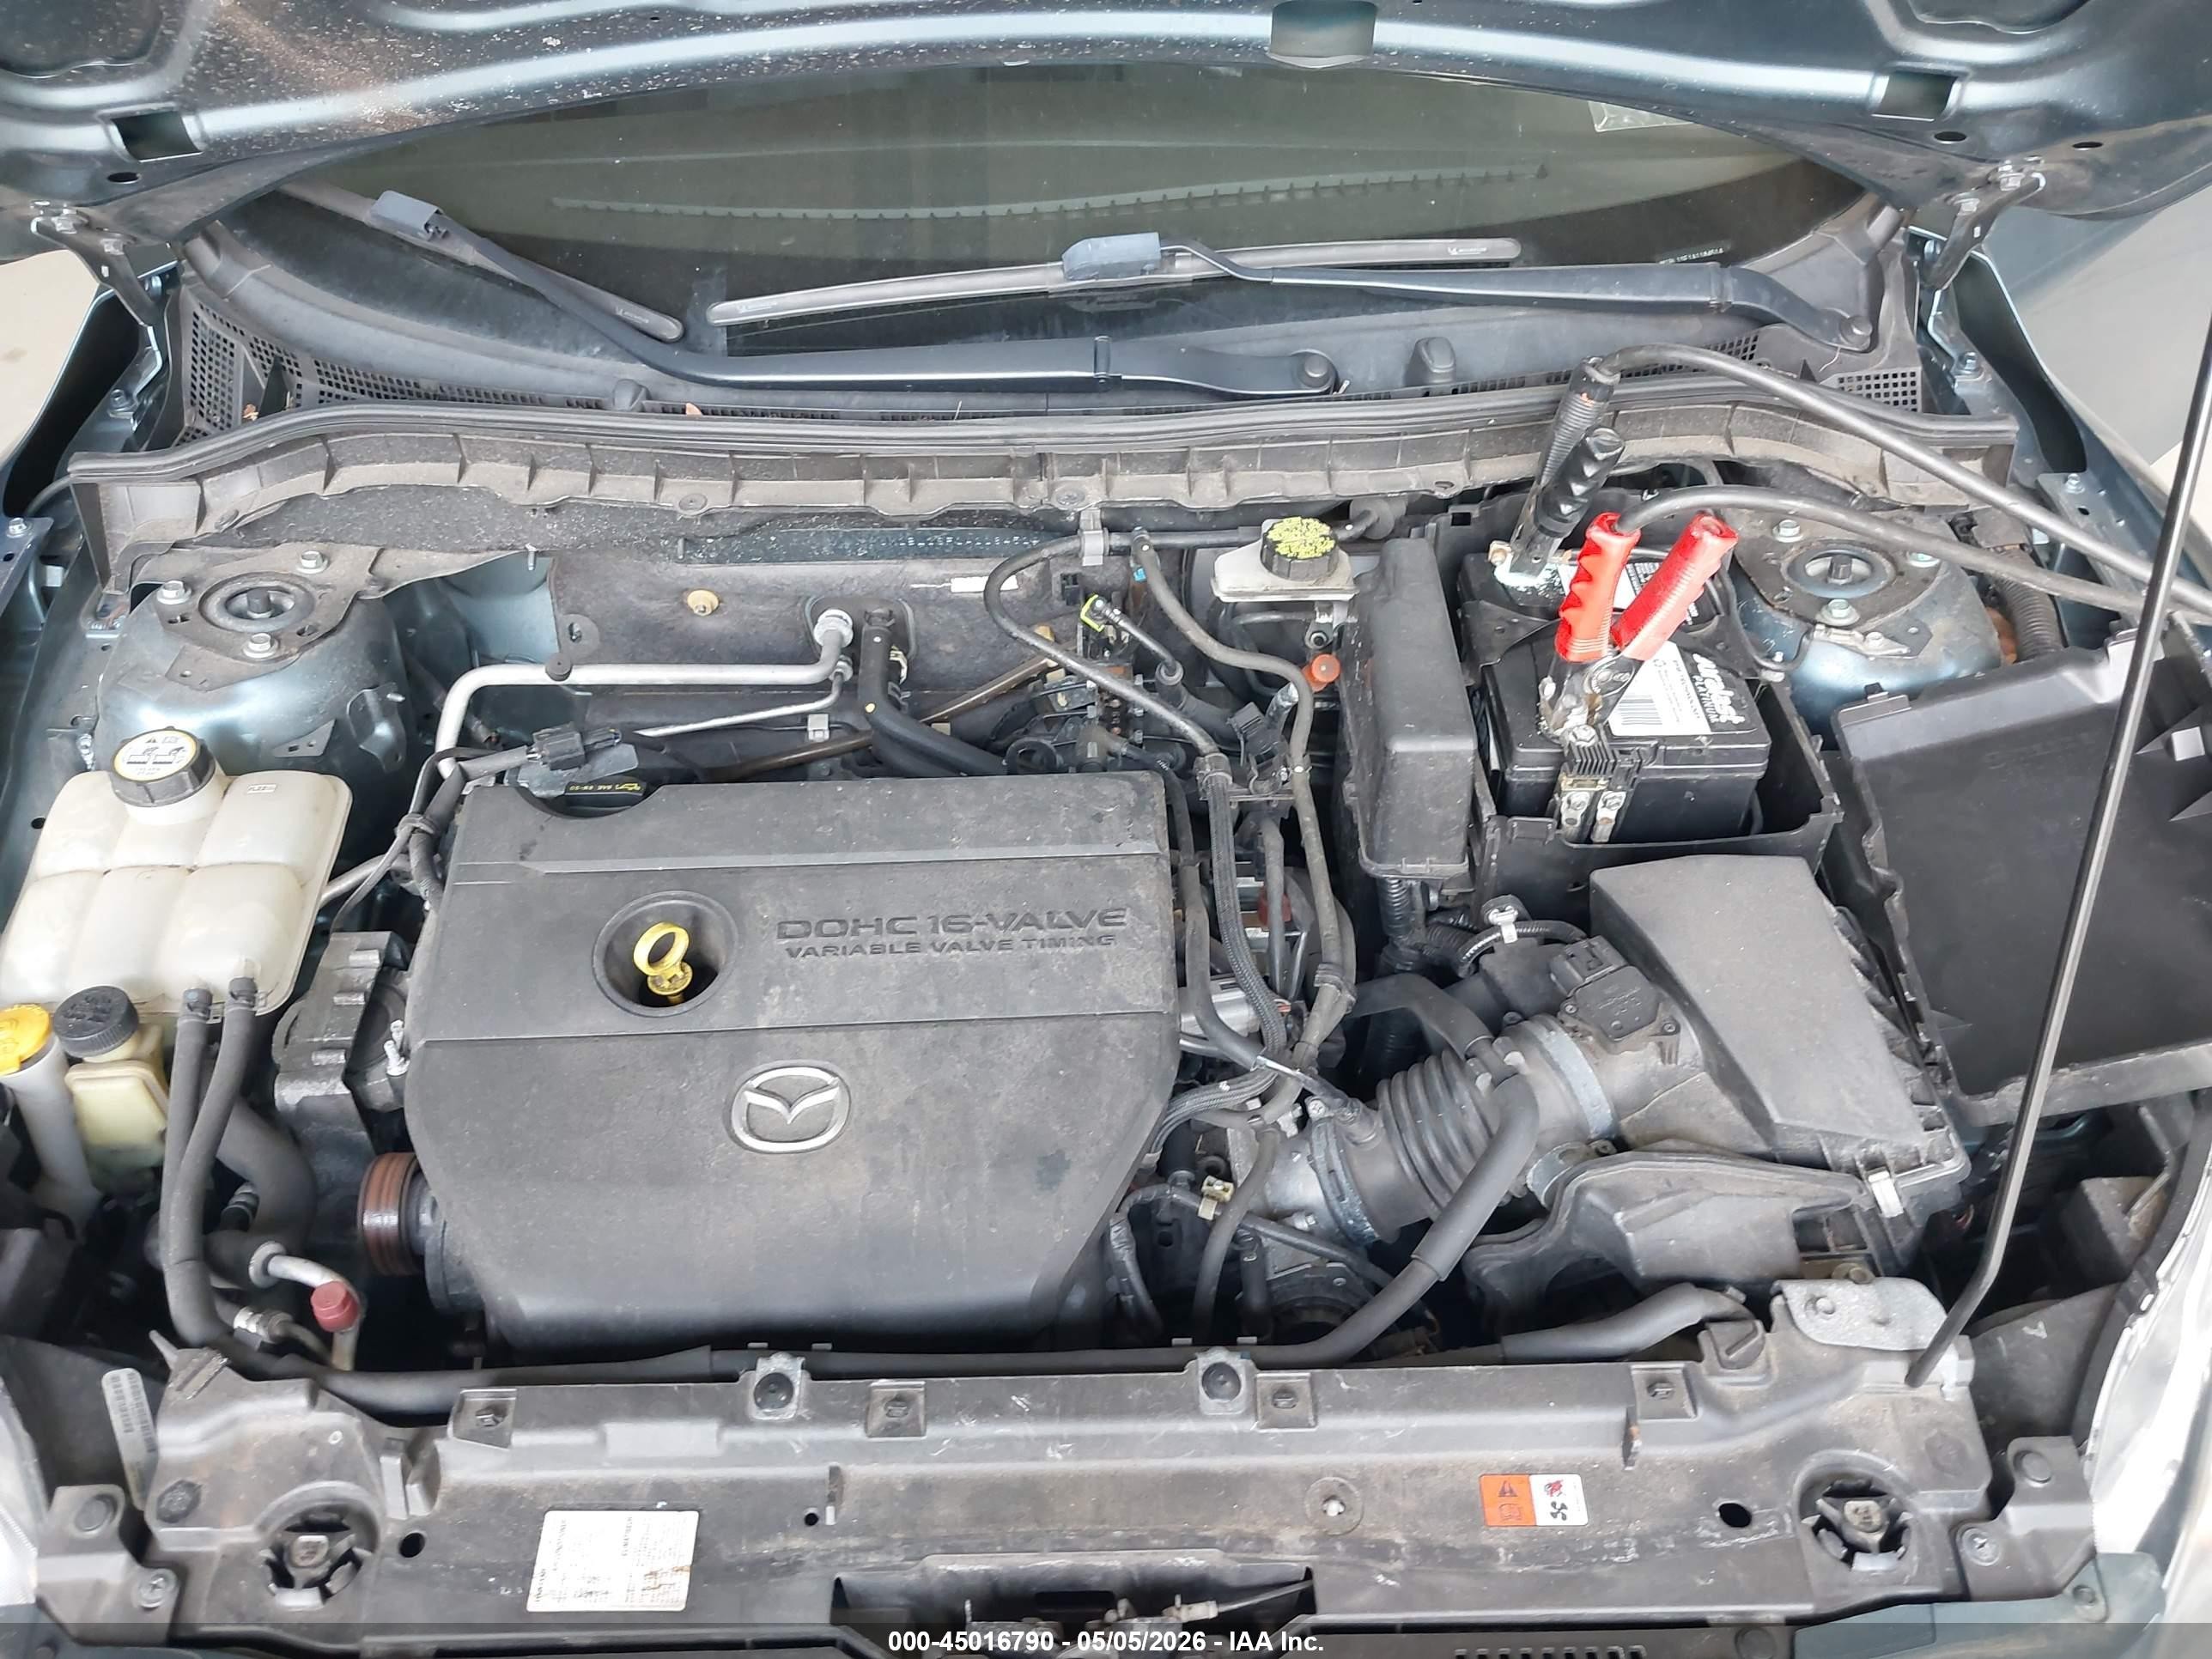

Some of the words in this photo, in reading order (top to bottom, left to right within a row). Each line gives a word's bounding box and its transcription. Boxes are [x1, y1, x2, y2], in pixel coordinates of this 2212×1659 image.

[1691, 674, 1720, 724] PLATINUM
[776, 915, 918, 939] DOHC
[927, 908, 1128, 934] 16-VALVE
[785, 941, 921, 958] VARIABLE
[931, 939, 1014, 953] VALVE
[1021, 934, 1115, 950] TIMING
